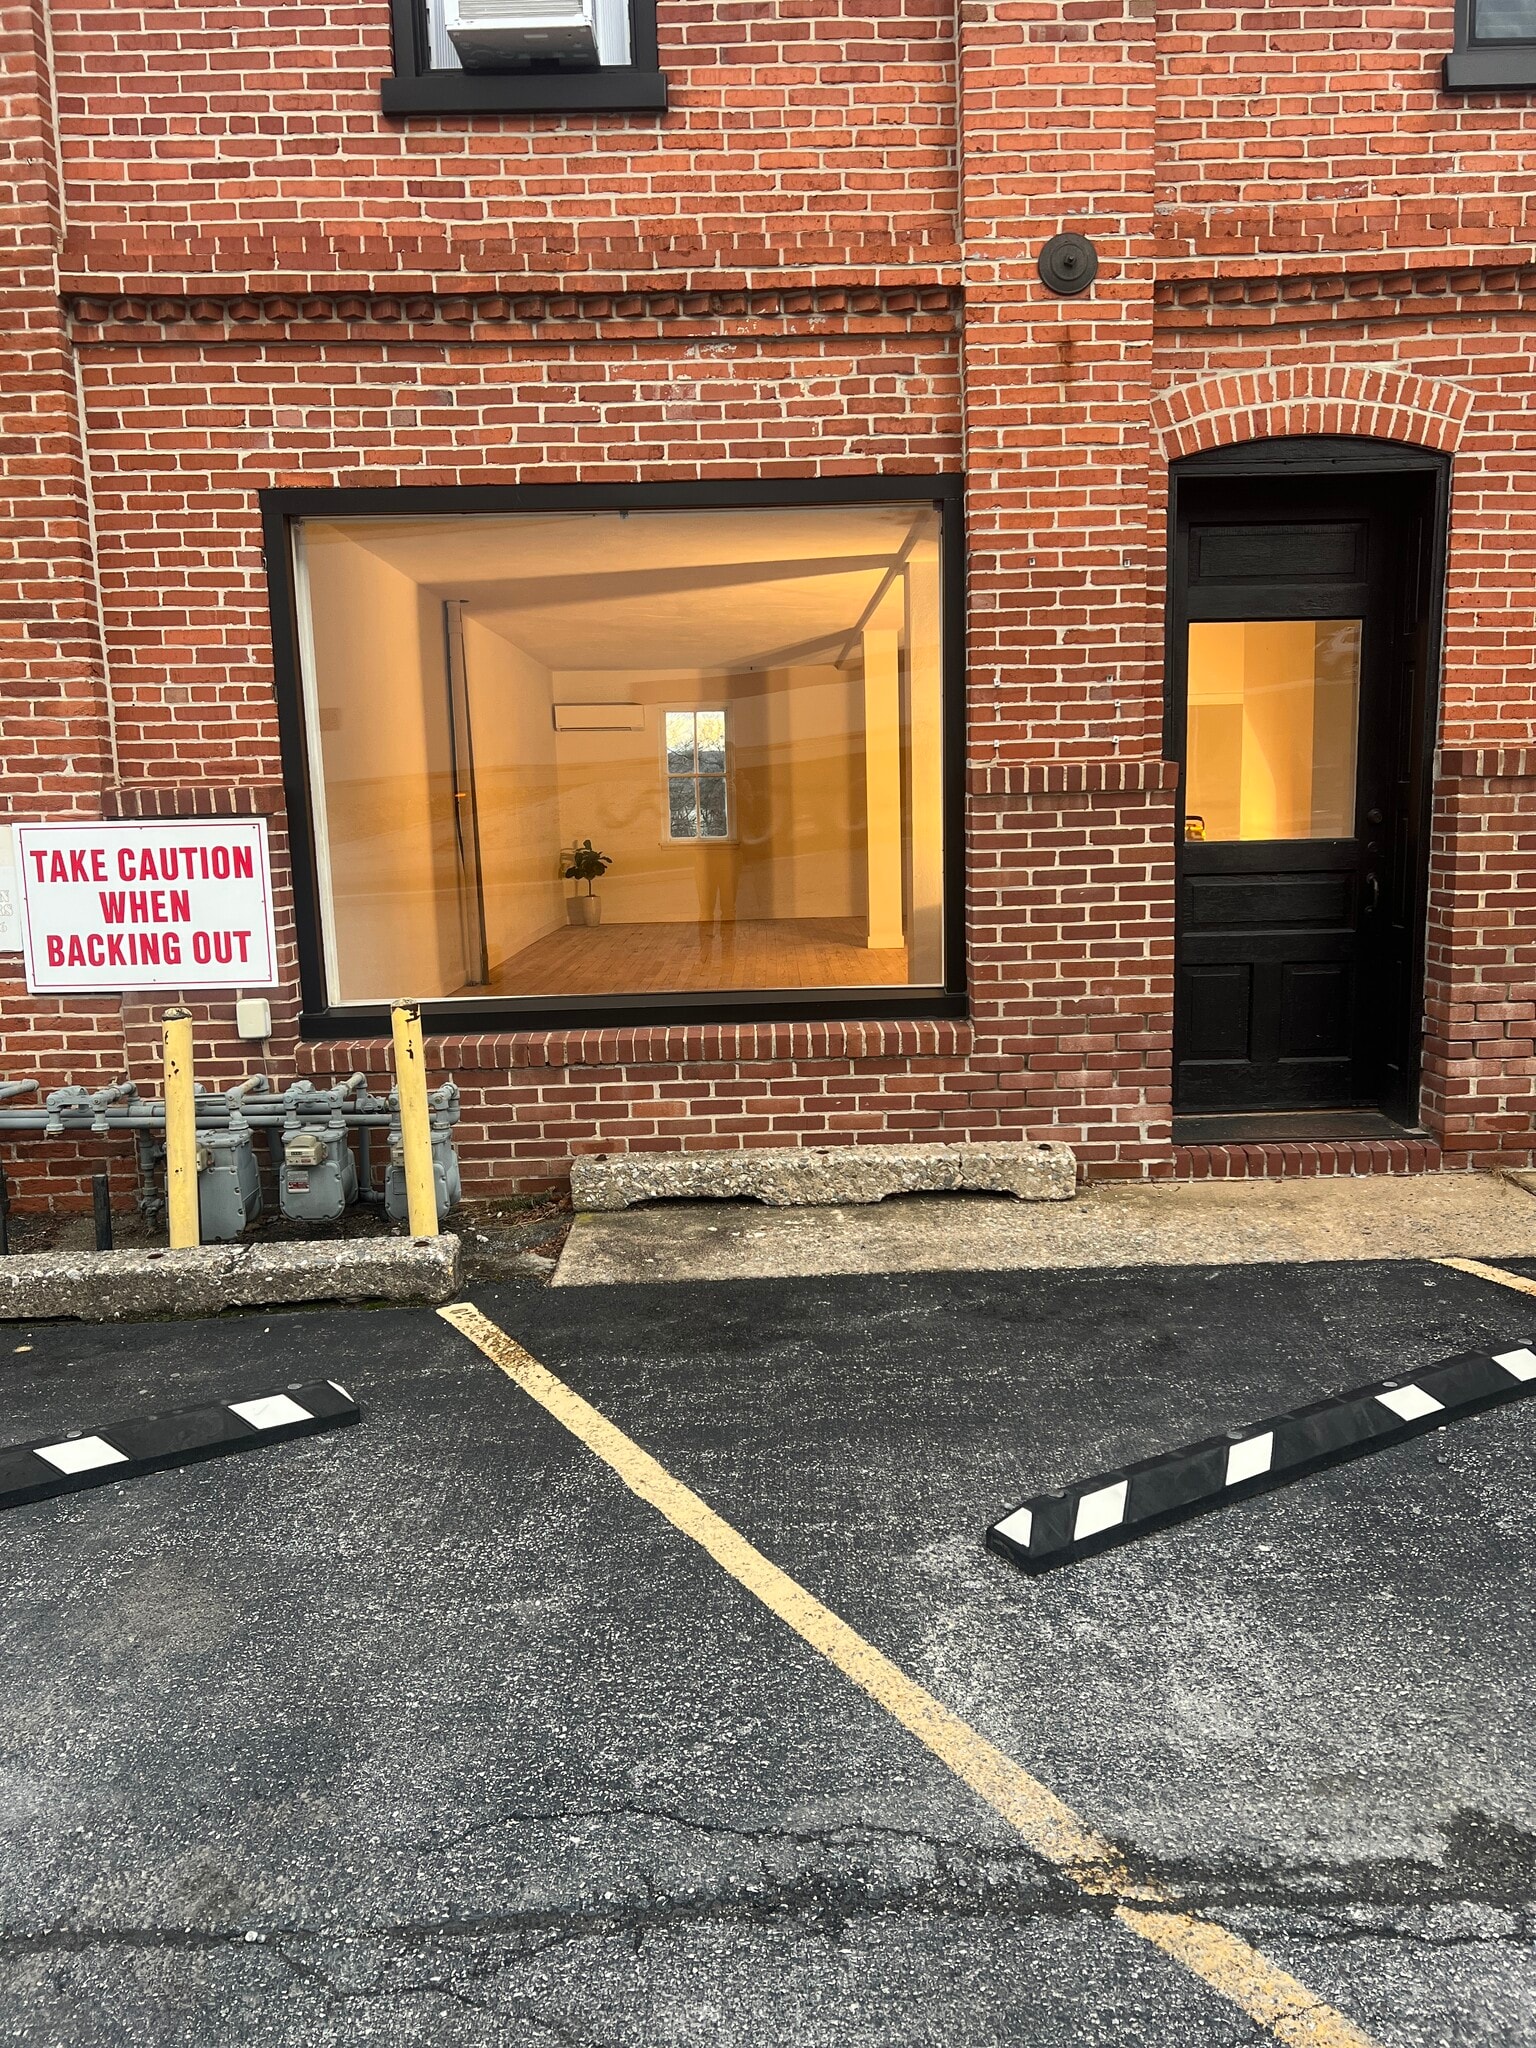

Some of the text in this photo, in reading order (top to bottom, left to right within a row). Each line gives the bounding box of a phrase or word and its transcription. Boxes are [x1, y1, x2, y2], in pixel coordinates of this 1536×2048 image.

[30, 846, 254, 882] TAKE CAUTION
[99, 890, 191, 923] WHEN
[47, 931, 251, 967] BACKING OUT
